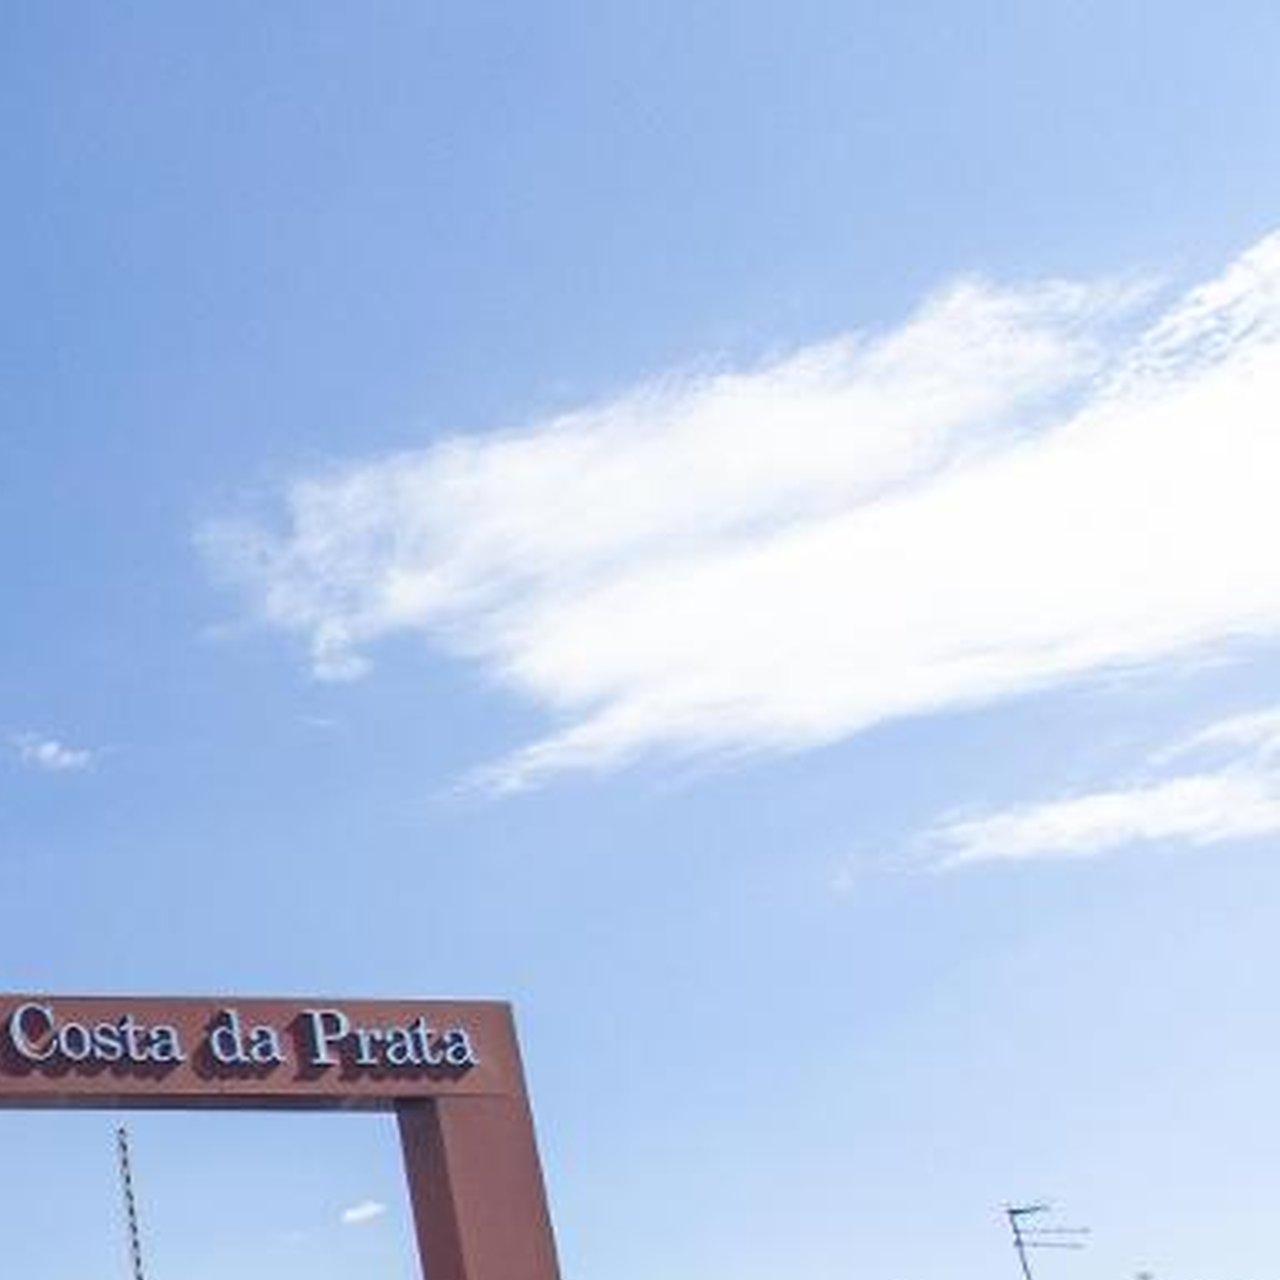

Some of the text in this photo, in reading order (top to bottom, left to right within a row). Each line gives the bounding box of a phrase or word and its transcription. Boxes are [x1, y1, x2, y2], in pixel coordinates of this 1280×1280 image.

[10, 1002, 185, 1061] Costa
[210, 1009, 285, 1063] da
[304, 1009, 479, 1066] Prata
